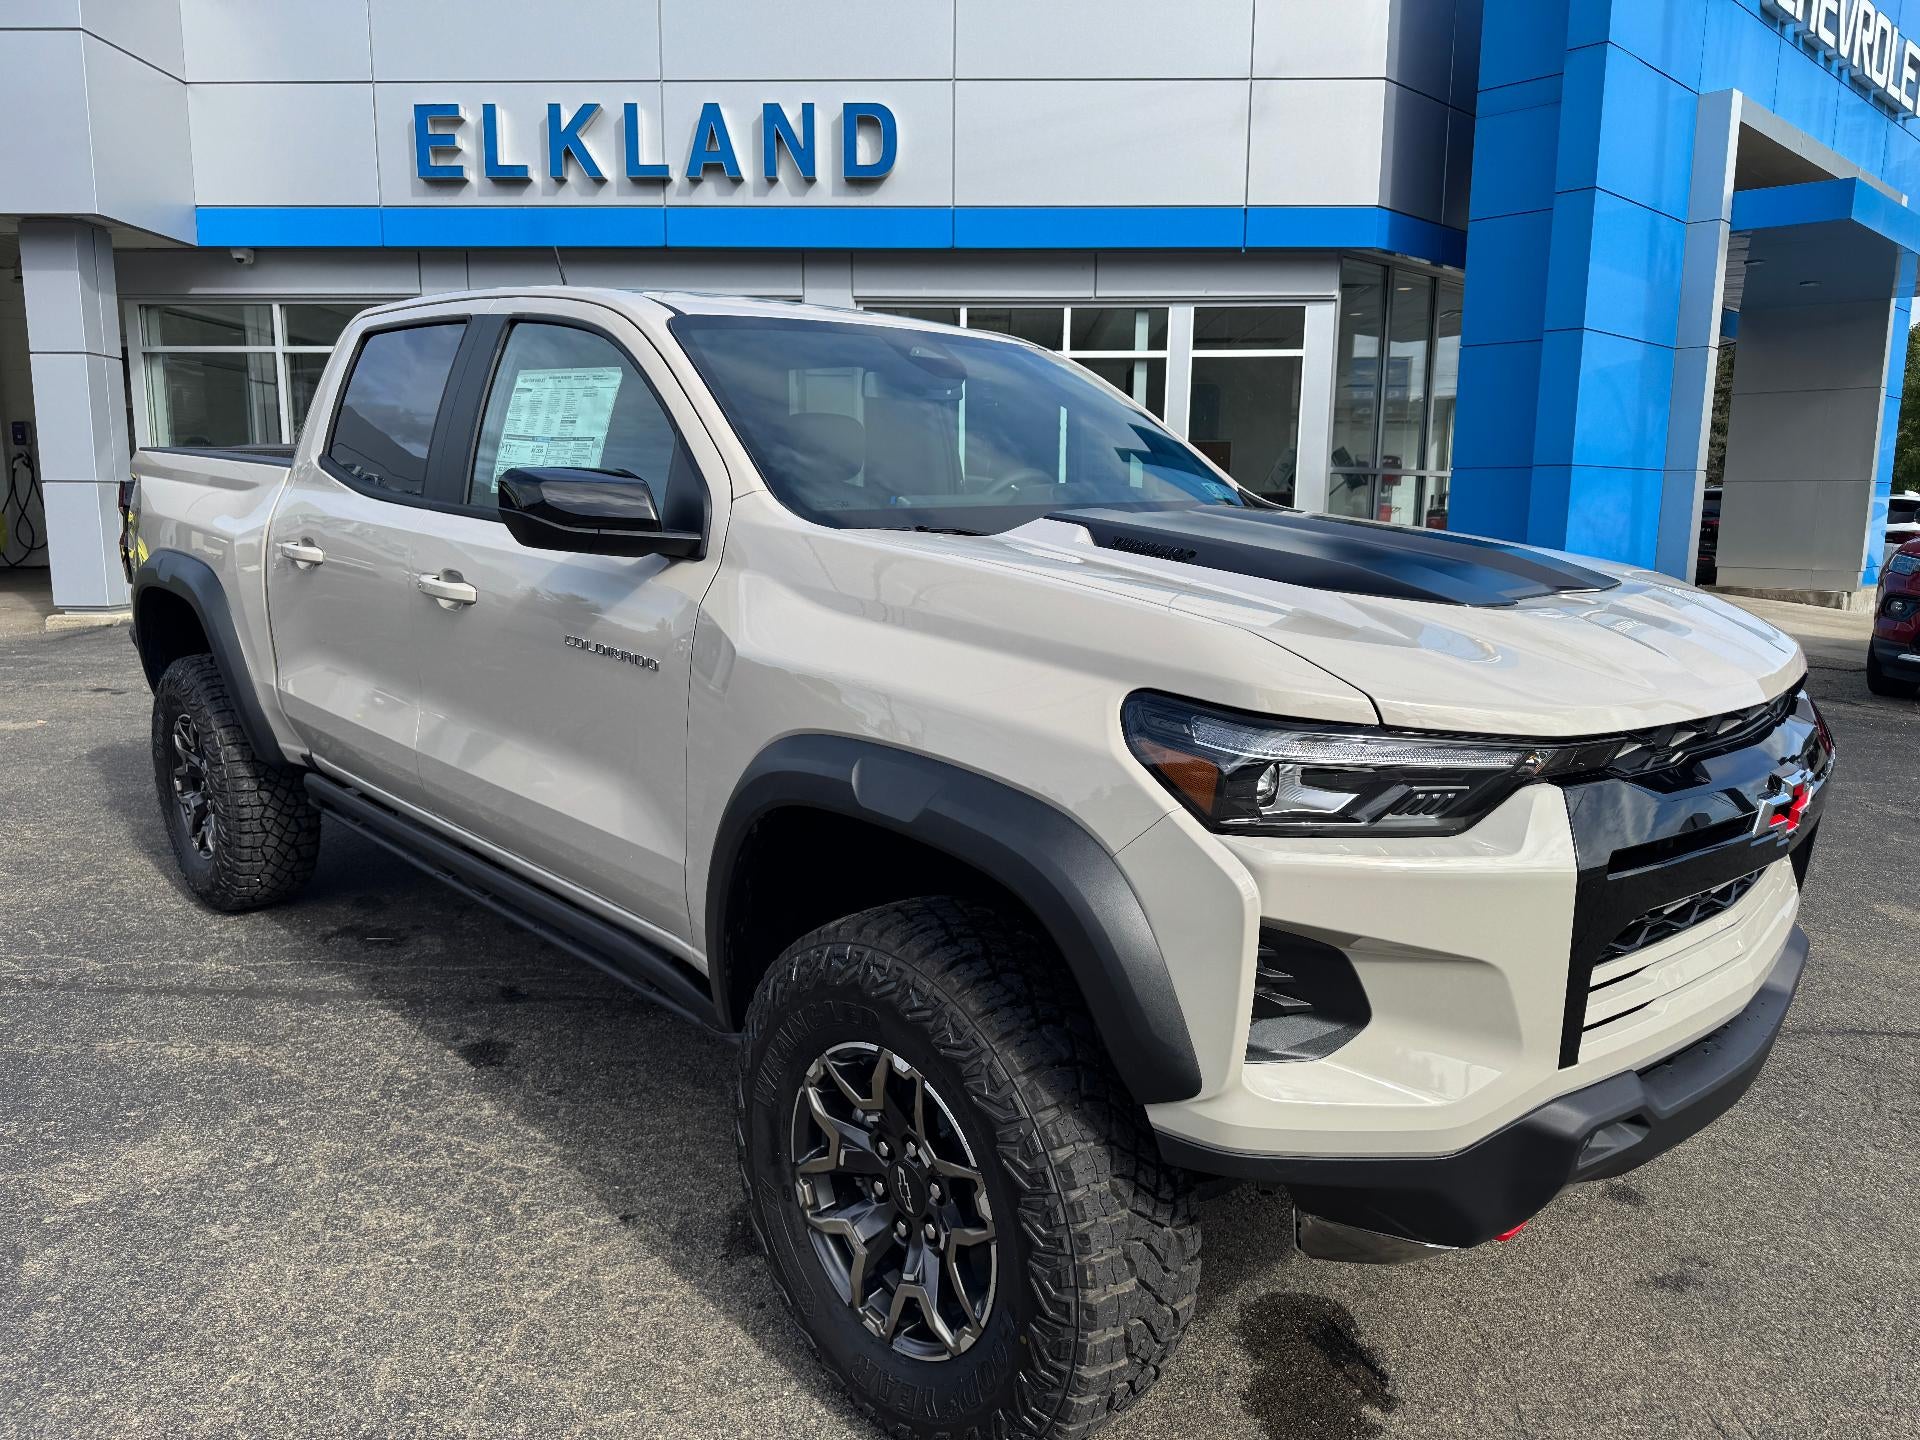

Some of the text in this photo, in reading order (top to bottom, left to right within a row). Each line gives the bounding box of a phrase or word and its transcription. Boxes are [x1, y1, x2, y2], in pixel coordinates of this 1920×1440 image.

[1773, 0, 1920, 117] EVROLE
[413, 102, 899, 182] ELKLAND
[564, 634, 660, 671] COLORADO
